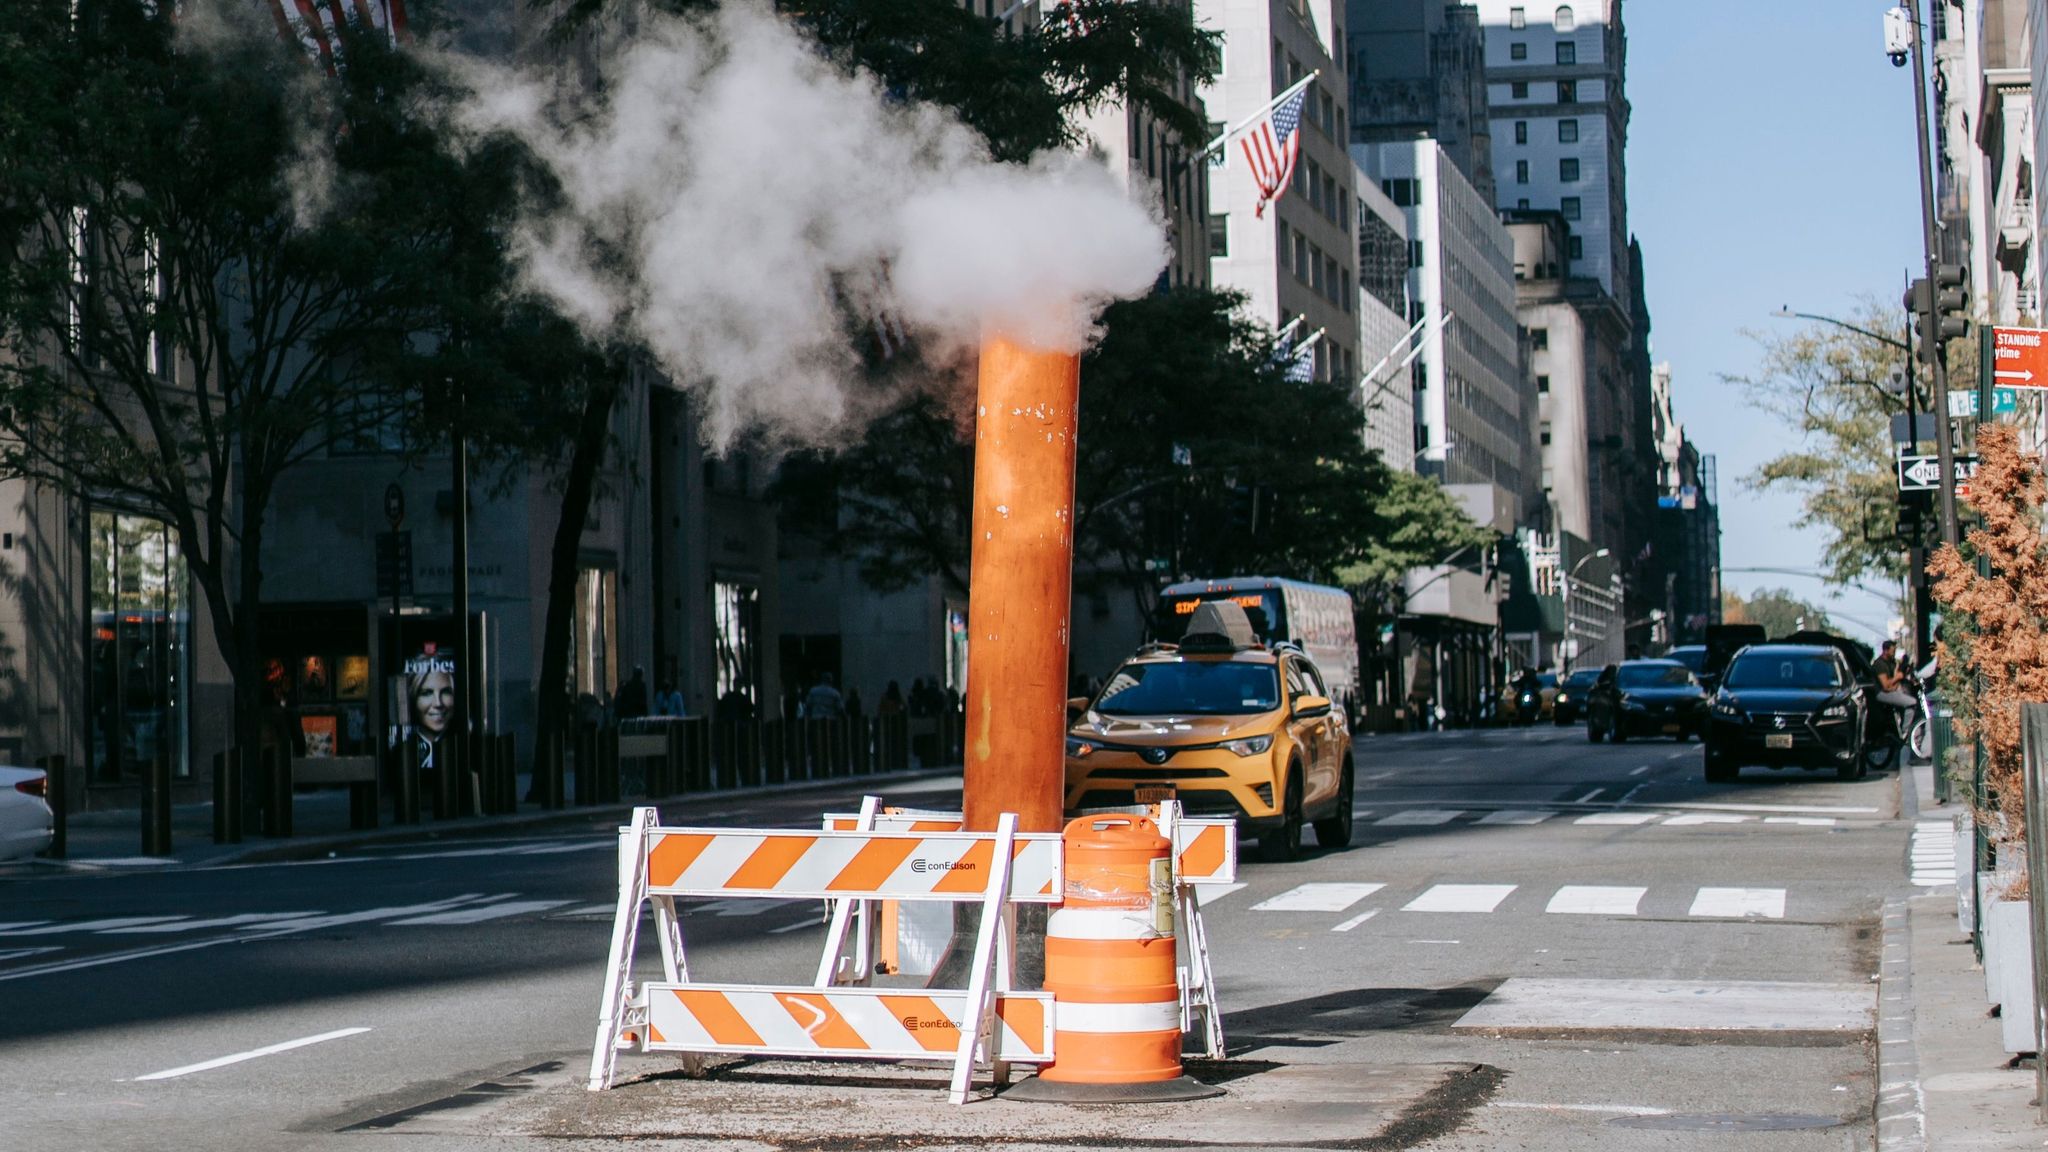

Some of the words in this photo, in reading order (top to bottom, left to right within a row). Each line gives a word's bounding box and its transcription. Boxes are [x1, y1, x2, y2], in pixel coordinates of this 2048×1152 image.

[1997, 333, 2041, 347] STANDING
[1995, 346, 2021, 361] ytime
[2002, 391, 2012, 405] St
[404, 657, 455, 674] Forbes
[927, 861, 976, 871] conEdison
